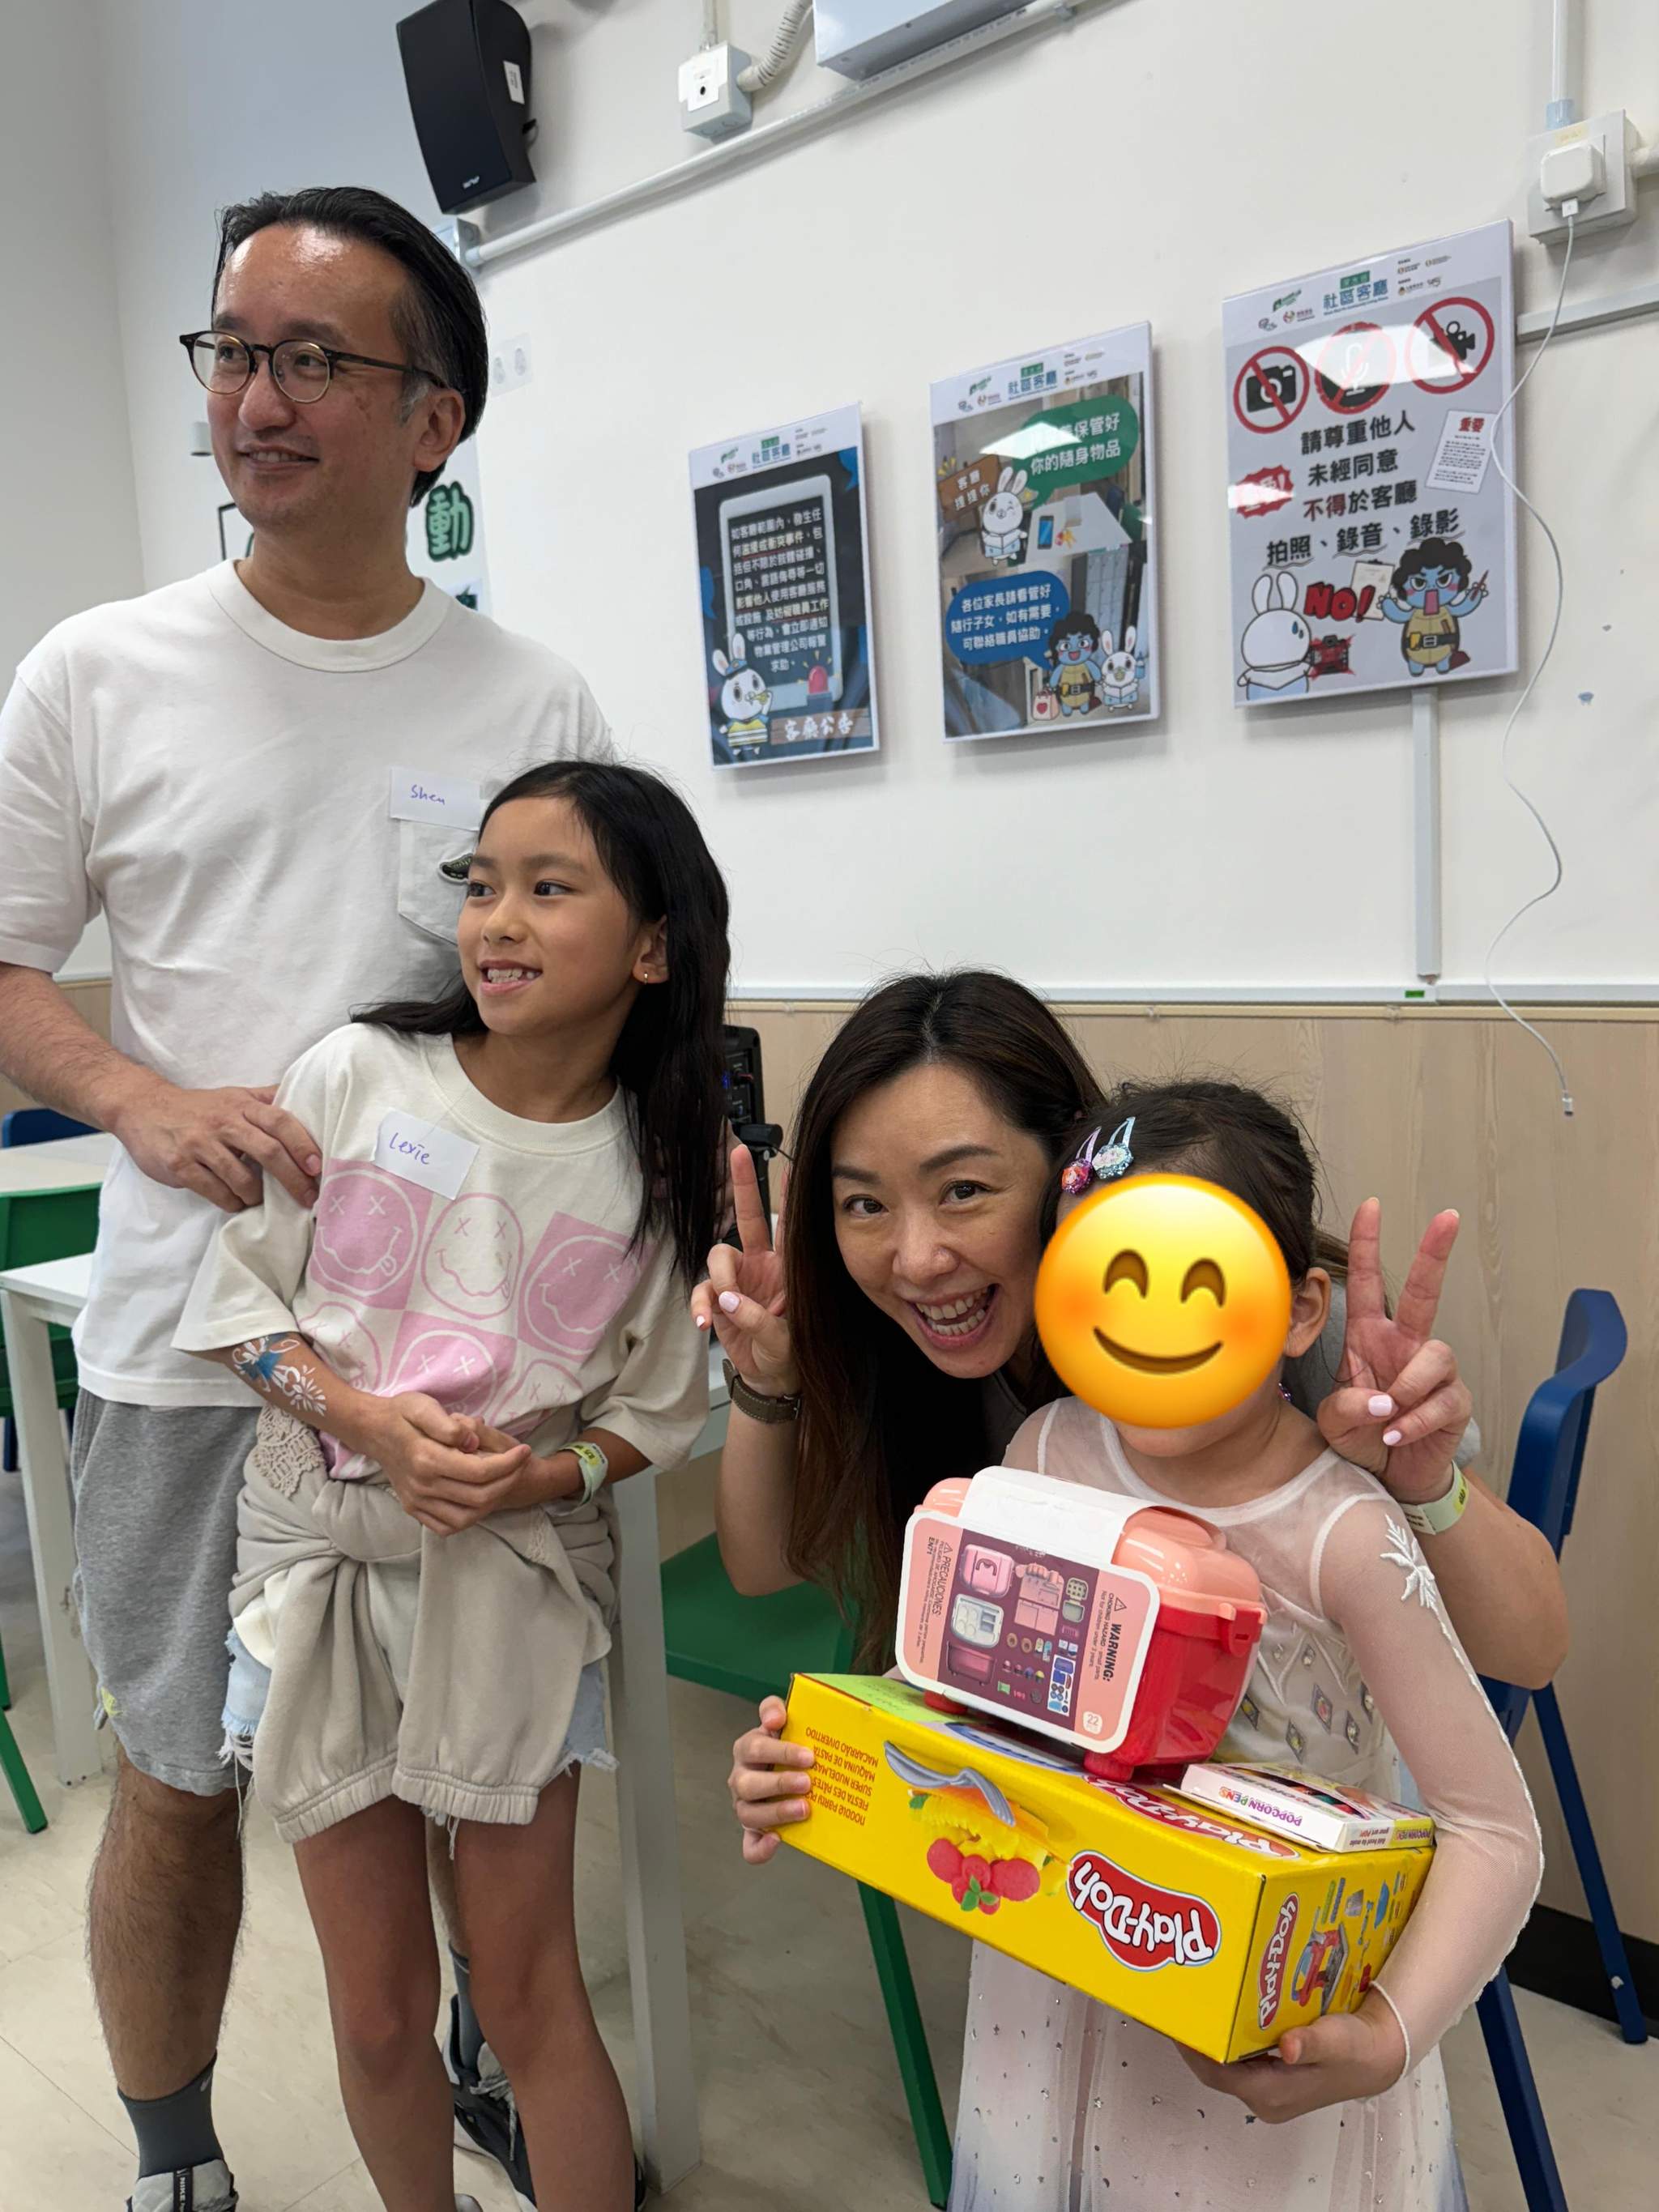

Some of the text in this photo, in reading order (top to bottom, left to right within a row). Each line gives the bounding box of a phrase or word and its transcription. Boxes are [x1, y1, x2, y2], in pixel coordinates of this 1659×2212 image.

[1322, 279, 1388, 309] 社區客廳
[1006, 369, 1057, 394] 社區客廳
[1300, 410, 1416, 454] 請尊重他人
[1030, 438, 1121, 475] 你的隨身物品
[1307, 448, 1400, 486] 未經同意
[1302, 479, 1418, 522] 不得於客廳
[426, 480, 474, 562] 動
[1266, 507, 1461, 566] 拍照、錄音、錄影
[961, 582, 1051, 613] 各位家長請看管好
[1303, 581, 1375, 623] NO!
[962, 626, 1048, 650] 可聯絡職員協助。
[389, 1132, 430, 1166] Lexie
[932, 1555, 951, 1615] PRECAUCIONES
[1102, 1622, 1121, 1682] WARNING:
[1088, 1714, 1099, 1724] 22
[806, 1727, 840, 1750] DIVERTIDO
[834, 1755, 842, 1766] DE
[834, 1787, 846, 1801] DES
[847, 1793, 869, 1811] FIESTA
[851, 1779, 872, 1796] SUPER
[1218, 1786, 1247, 1806] PENS
[1247, 1798, 1302, 1826] POPCORN
